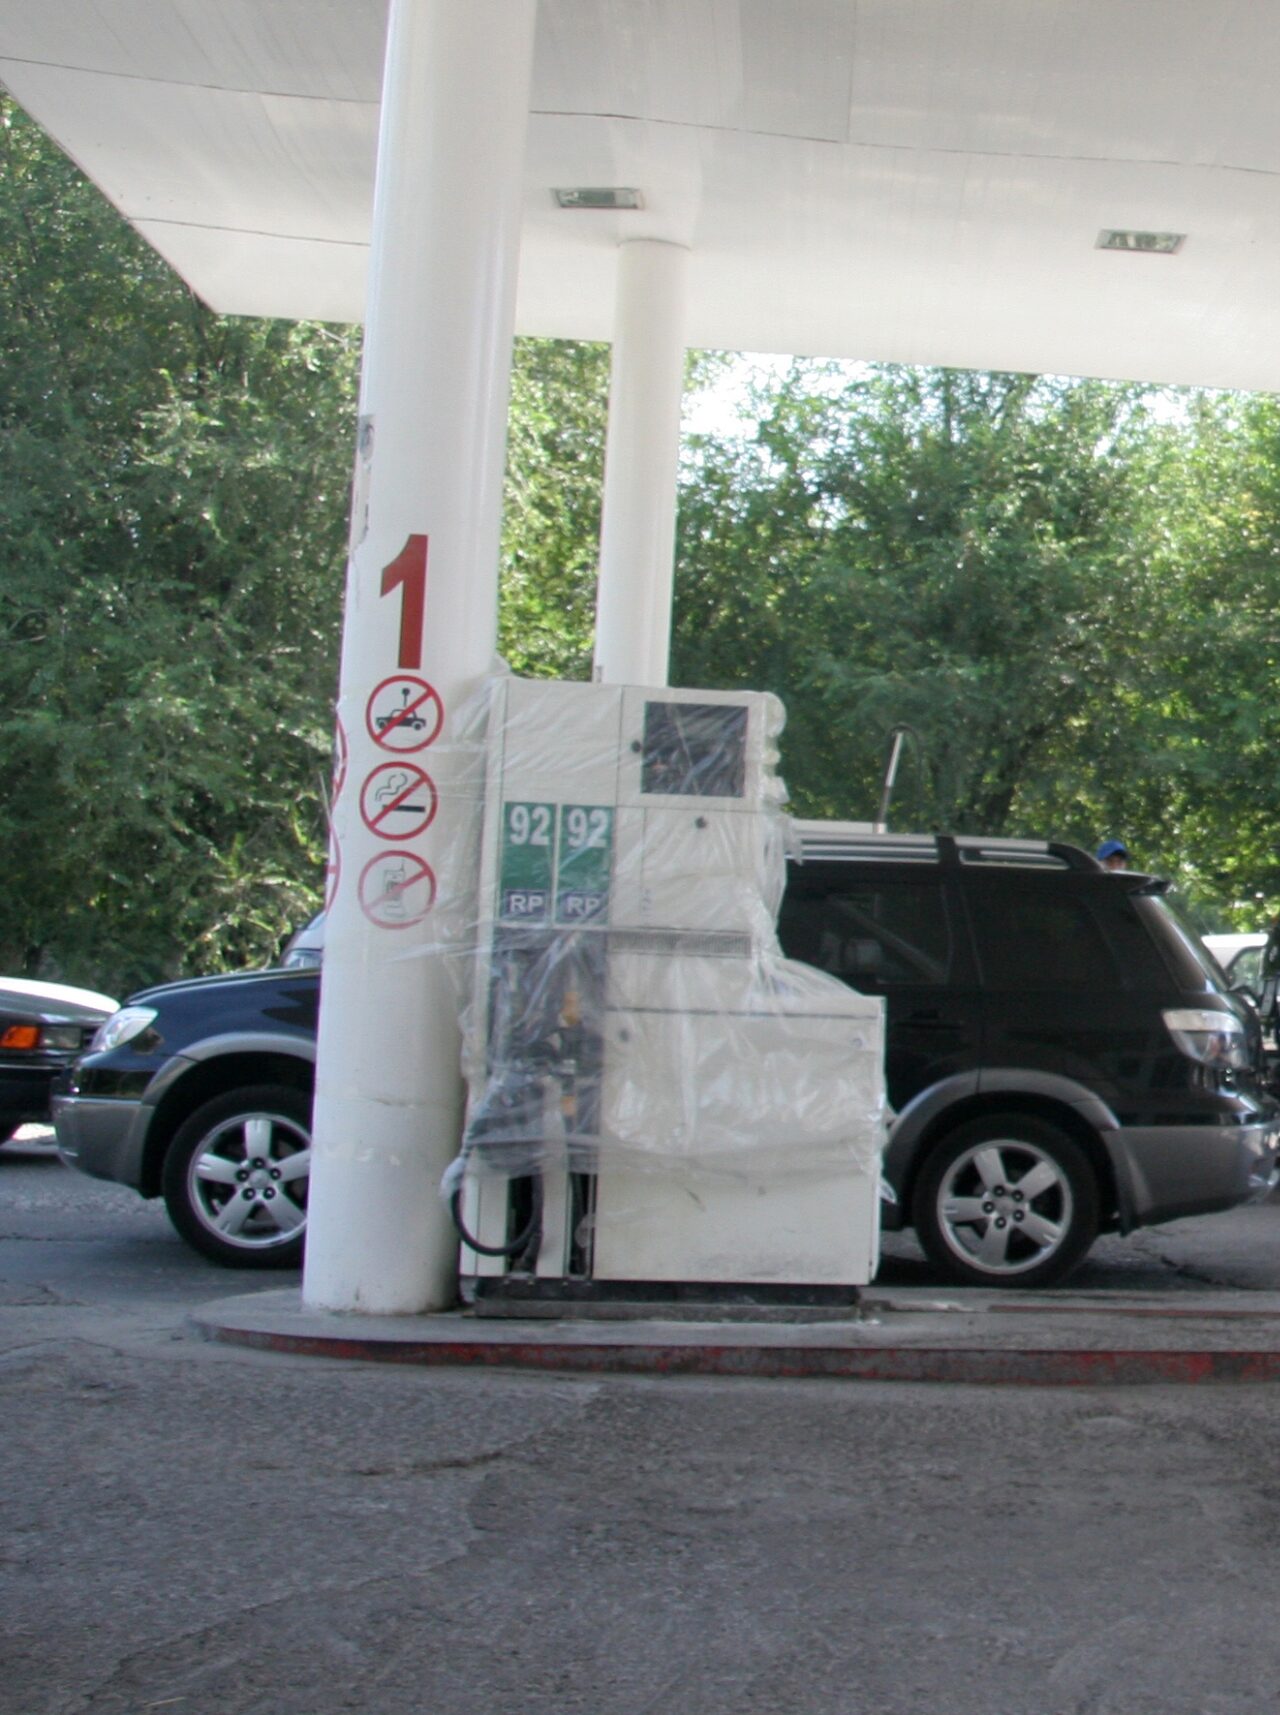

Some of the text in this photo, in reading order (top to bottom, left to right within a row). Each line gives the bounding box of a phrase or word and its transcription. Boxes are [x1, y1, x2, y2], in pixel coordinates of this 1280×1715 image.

[380, 533, 428, 669] 1
[510, 805, 551, 845] 92
[567, 808, 609, 847] 92
[509, 894, 544, 913] RP
[567, 897, 600, 914] RP
